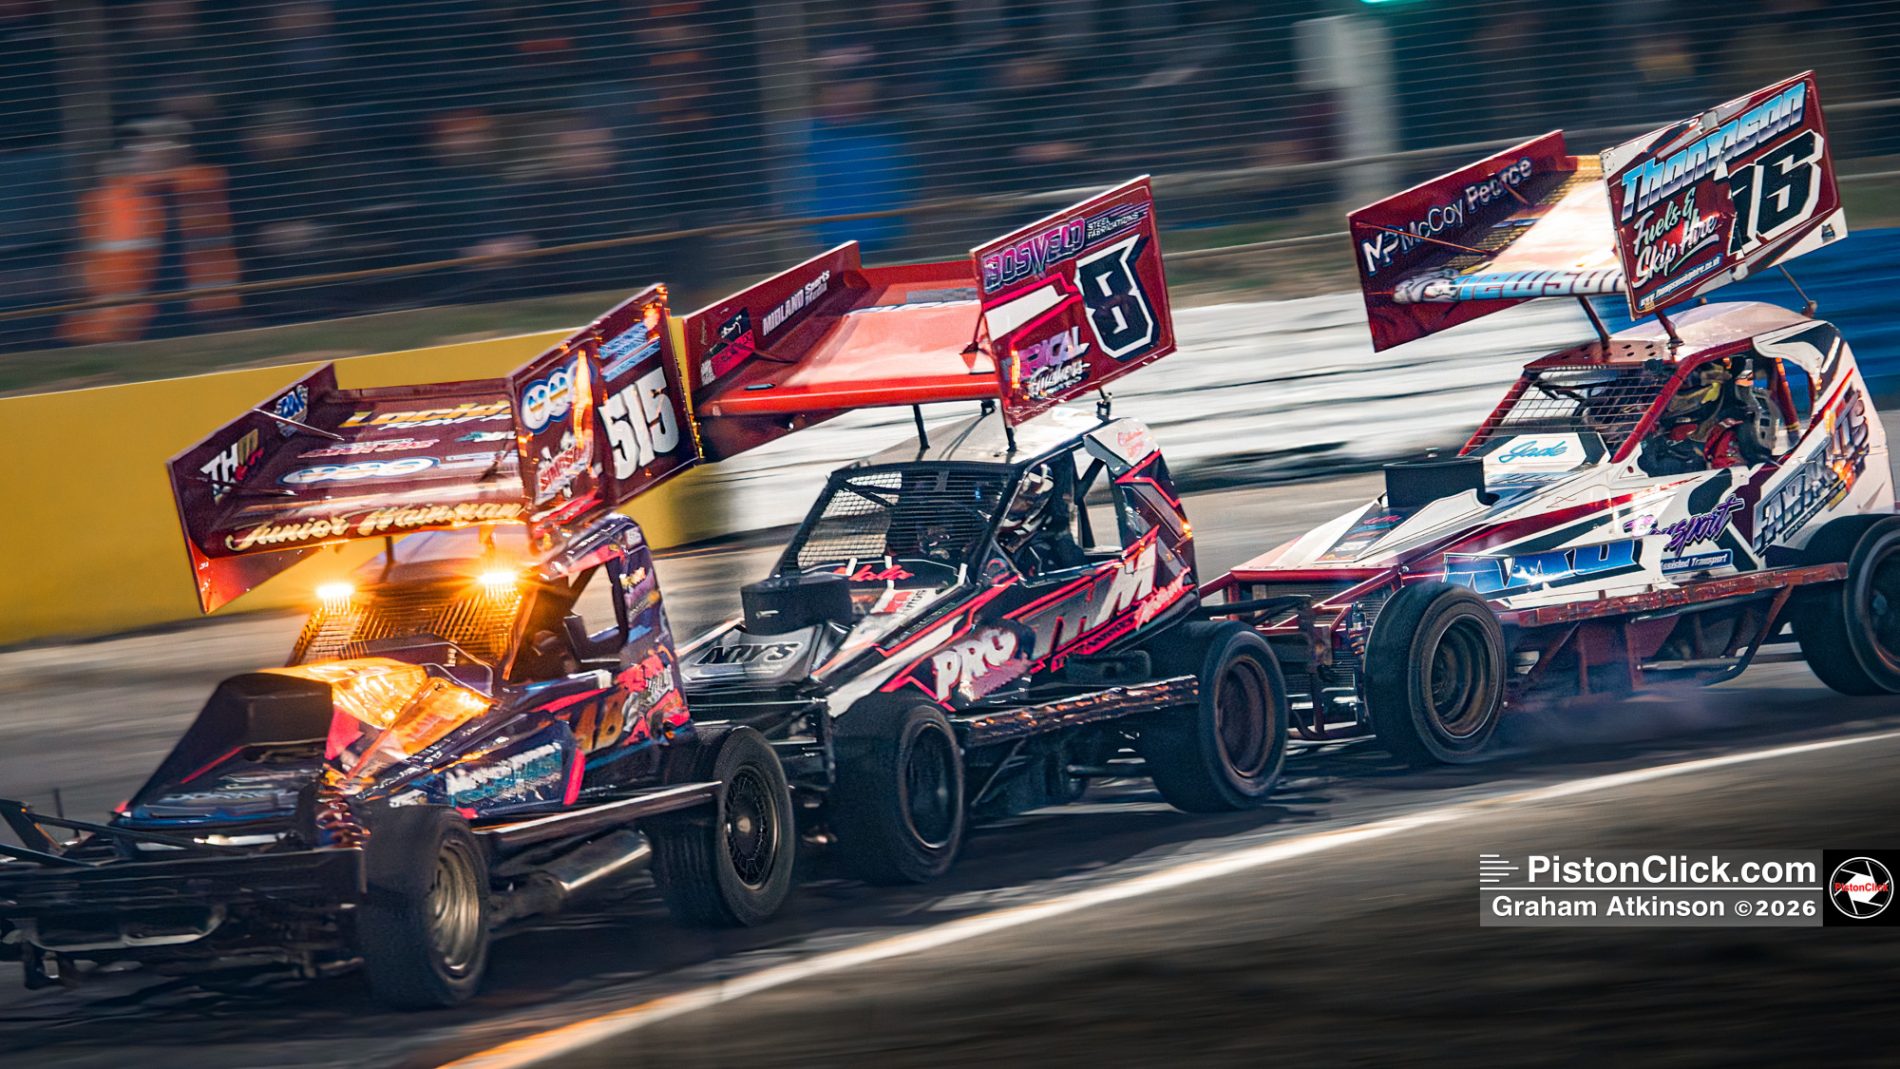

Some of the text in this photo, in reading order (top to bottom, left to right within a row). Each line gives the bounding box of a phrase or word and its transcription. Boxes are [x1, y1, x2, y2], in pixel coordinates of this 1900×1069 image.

[1086, 217, 1110, 231] STEEL
[1401, 199, 1463, 250] McCoy
[1465, 159, 1532, 212] Pearce
[1634, 200, 1681, 256] Fuels
[1728, 129, 1825, 258] 16
[1074, 234, 1154, 359] 8
[1632, 240, 1677, 288] Skip
[597, 366, 680, 480] 515
[1499, 441, 1568, 463] Jade
[932, 628, 1019, 703] PRO
